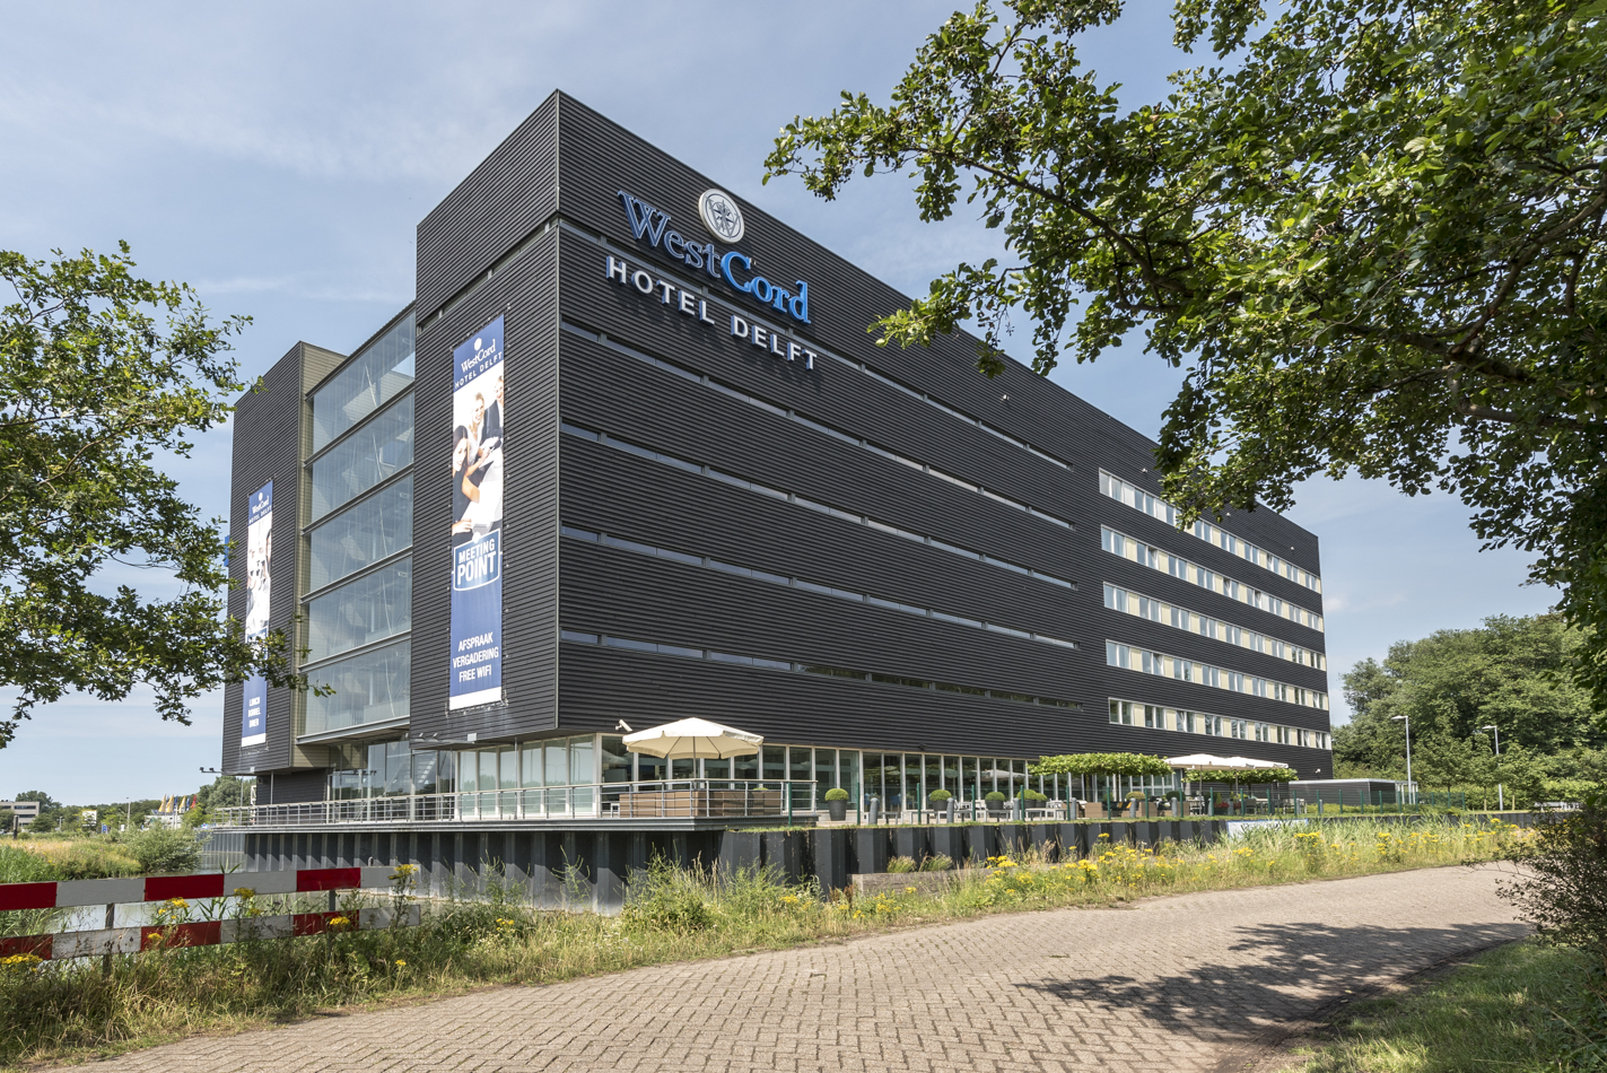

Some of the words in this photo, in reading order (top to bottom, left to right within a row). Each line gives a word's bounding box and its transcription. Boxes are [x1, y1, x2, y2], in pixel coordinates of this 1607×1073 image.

[617, 190, 811, 324] WestCord
[606, 256, 715, 325] HOTEL
[731, 315, 818, 370] DELFT
[454, 370, 477, 389] HOTEL
[480, 352, 502, 372] DELFT
[461, 338, 496, 373] WestCord
[457, 551, 497, 586] POINT
[458, 538, 495, 564] MEETING
[452, 646, 499, 669] VERGADERING
[458, 632, 493, 652] AFSPRAAK
[459, 668, 476, 683] FREE
[477, 664, 492, 678] WIFI
